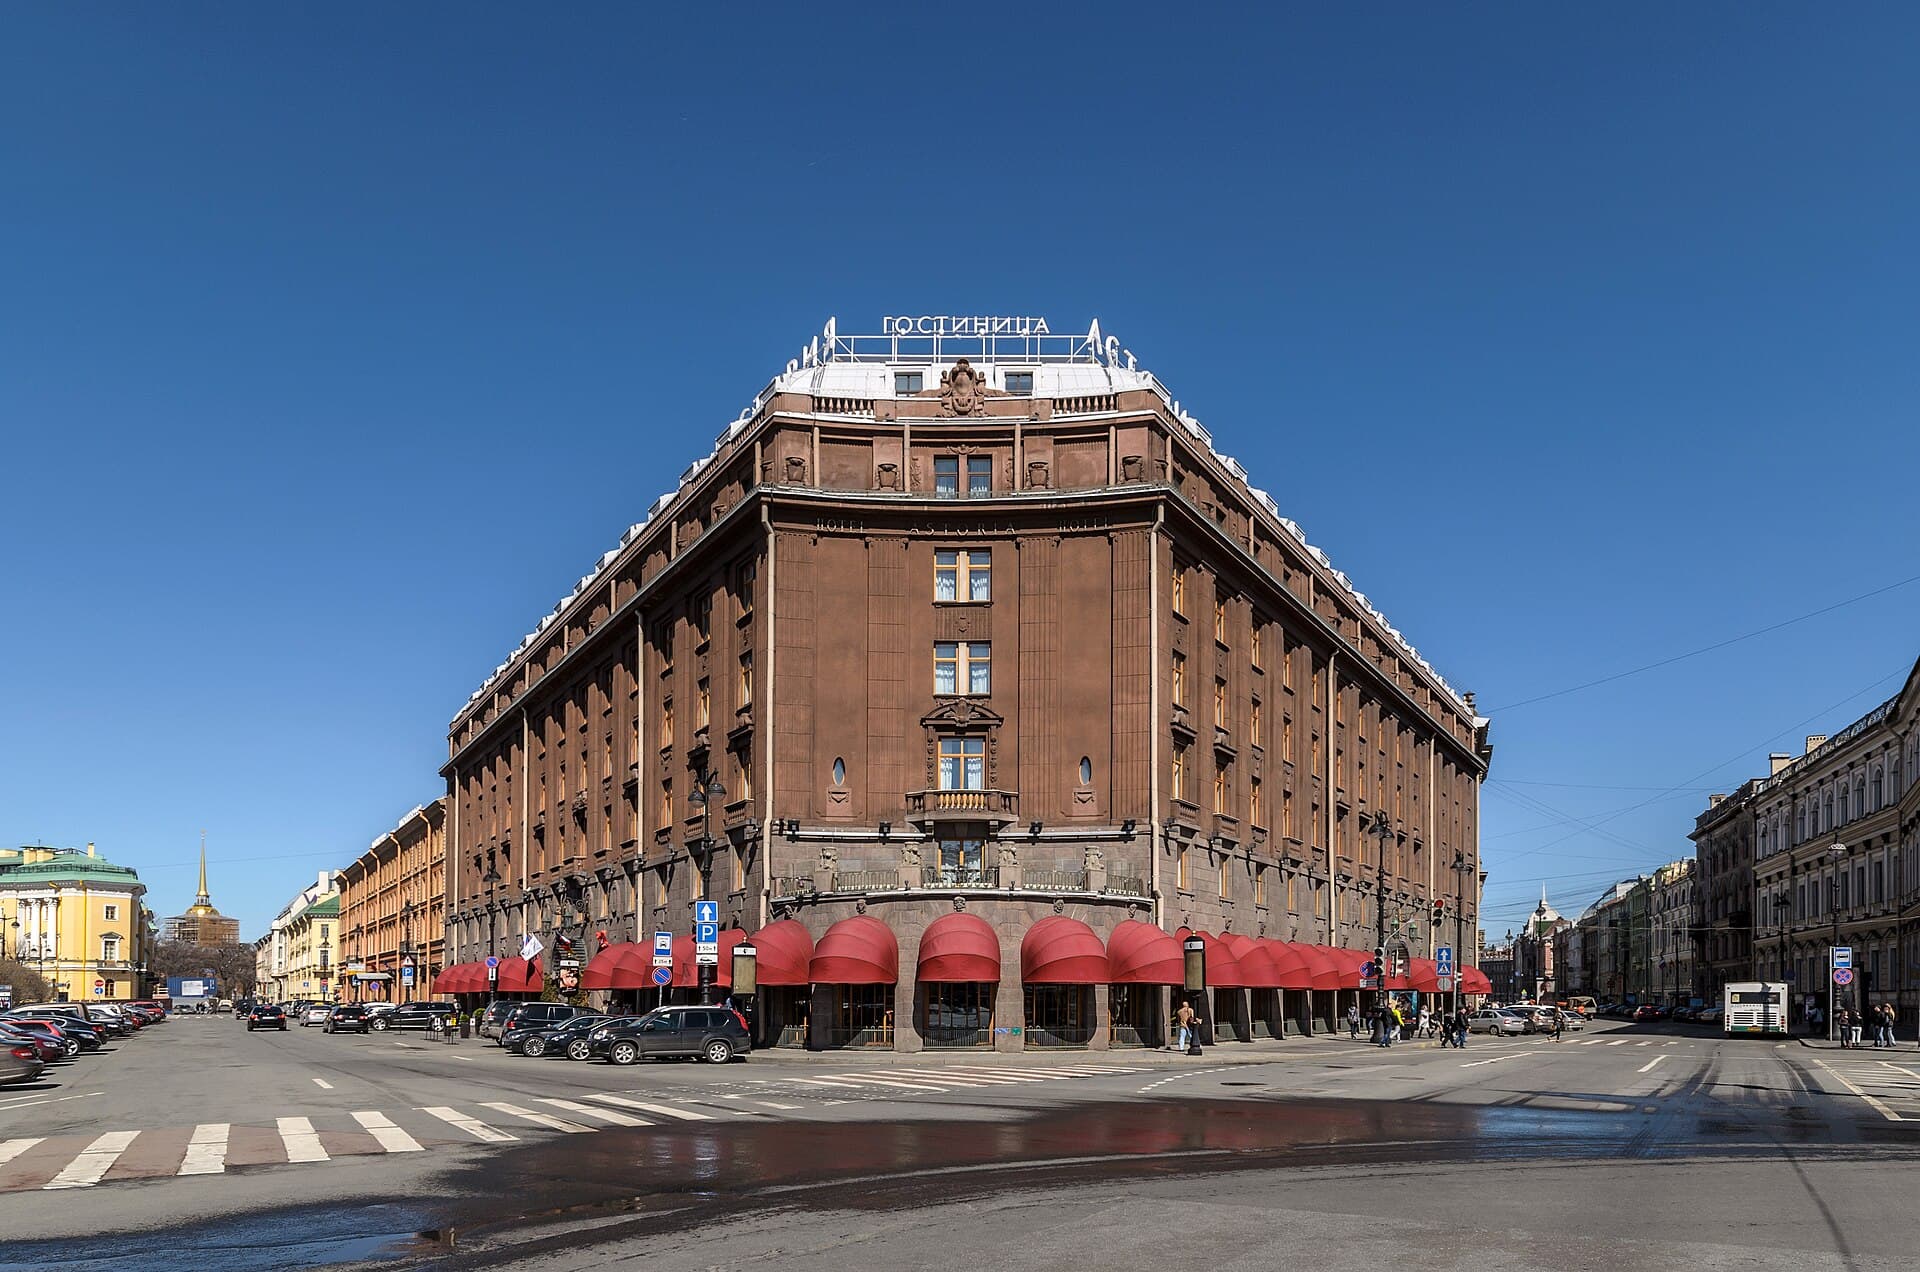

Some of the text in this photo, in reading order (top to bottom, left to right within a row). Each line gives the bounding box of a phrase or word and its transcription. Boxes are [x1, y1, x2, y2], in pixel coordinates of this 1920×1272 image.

[883, 316, 1050, 335] ГОСТИНИЦА
[909, 520, 1017, 536] ASTORIA
[702, 925, 714, 942] P
